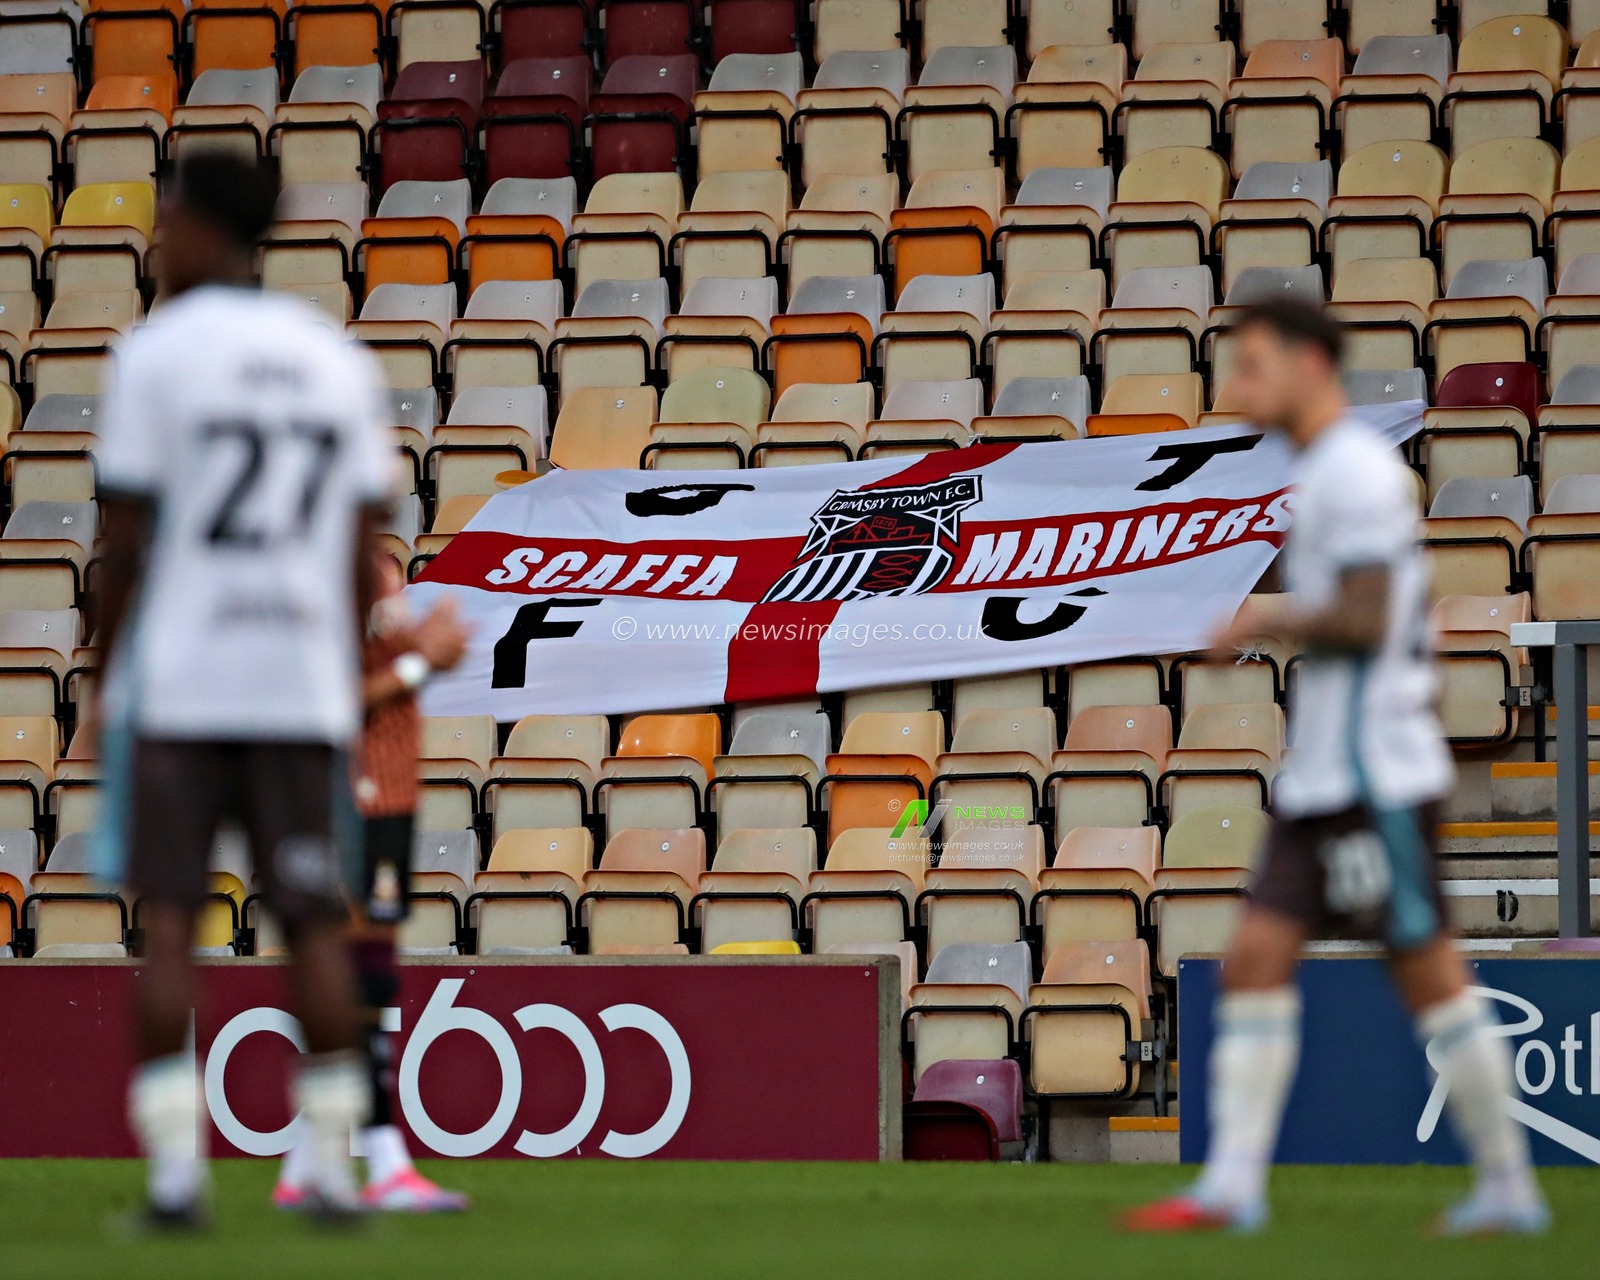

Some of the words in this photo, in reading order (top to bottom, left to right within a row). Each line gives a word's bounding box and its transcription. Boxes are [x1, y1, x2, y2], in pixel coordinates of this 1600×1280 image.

[199, 420, 339, 548] 27
[1134, 433, 1265, 491] T
[829, 497, 889, 512] GRIMSBY
[891, 490, 941, 509] TOWN
[485, 547, 739, 597] SCAFFA
[951, 493, 1297, 586] MARINERS
[490, 598, 604, 689] F
[1496, 889, 1519, 922] D
